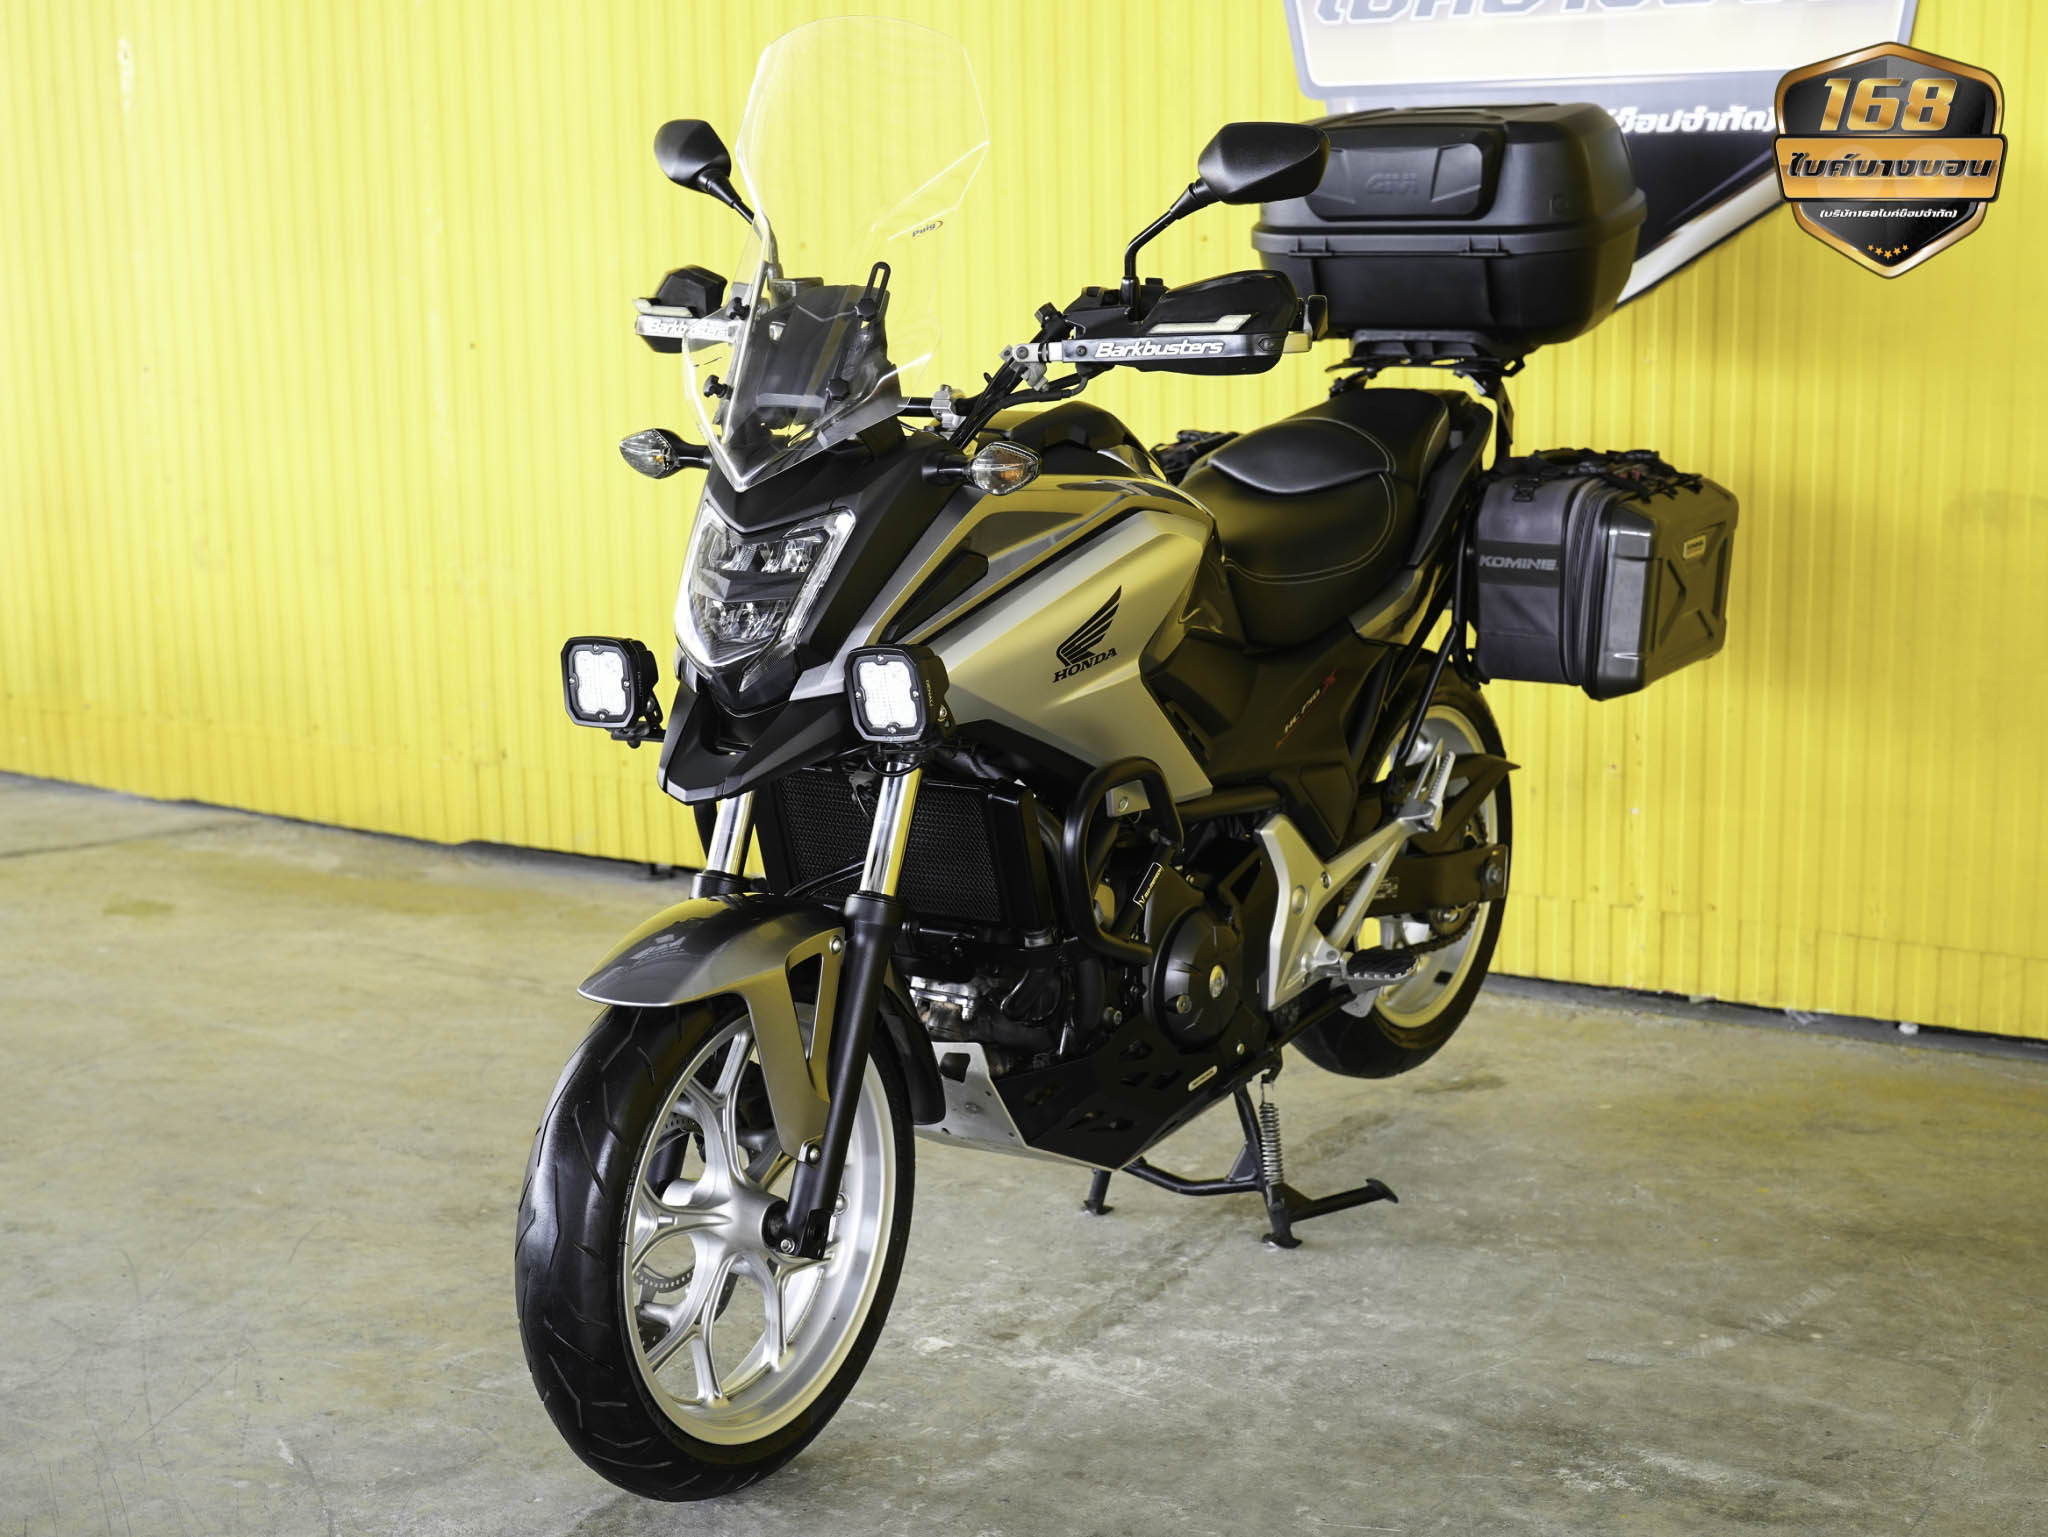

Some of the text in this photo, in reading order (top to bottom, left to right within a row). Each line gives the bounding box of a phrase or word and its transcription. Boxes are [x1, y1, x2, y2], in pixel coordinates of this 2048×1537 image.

[1095, 339, 1224, 358] Barkbusters
[1479, 555, 1558, 571] KOMINE
[1052, 647, 1118, 683] HONDA
